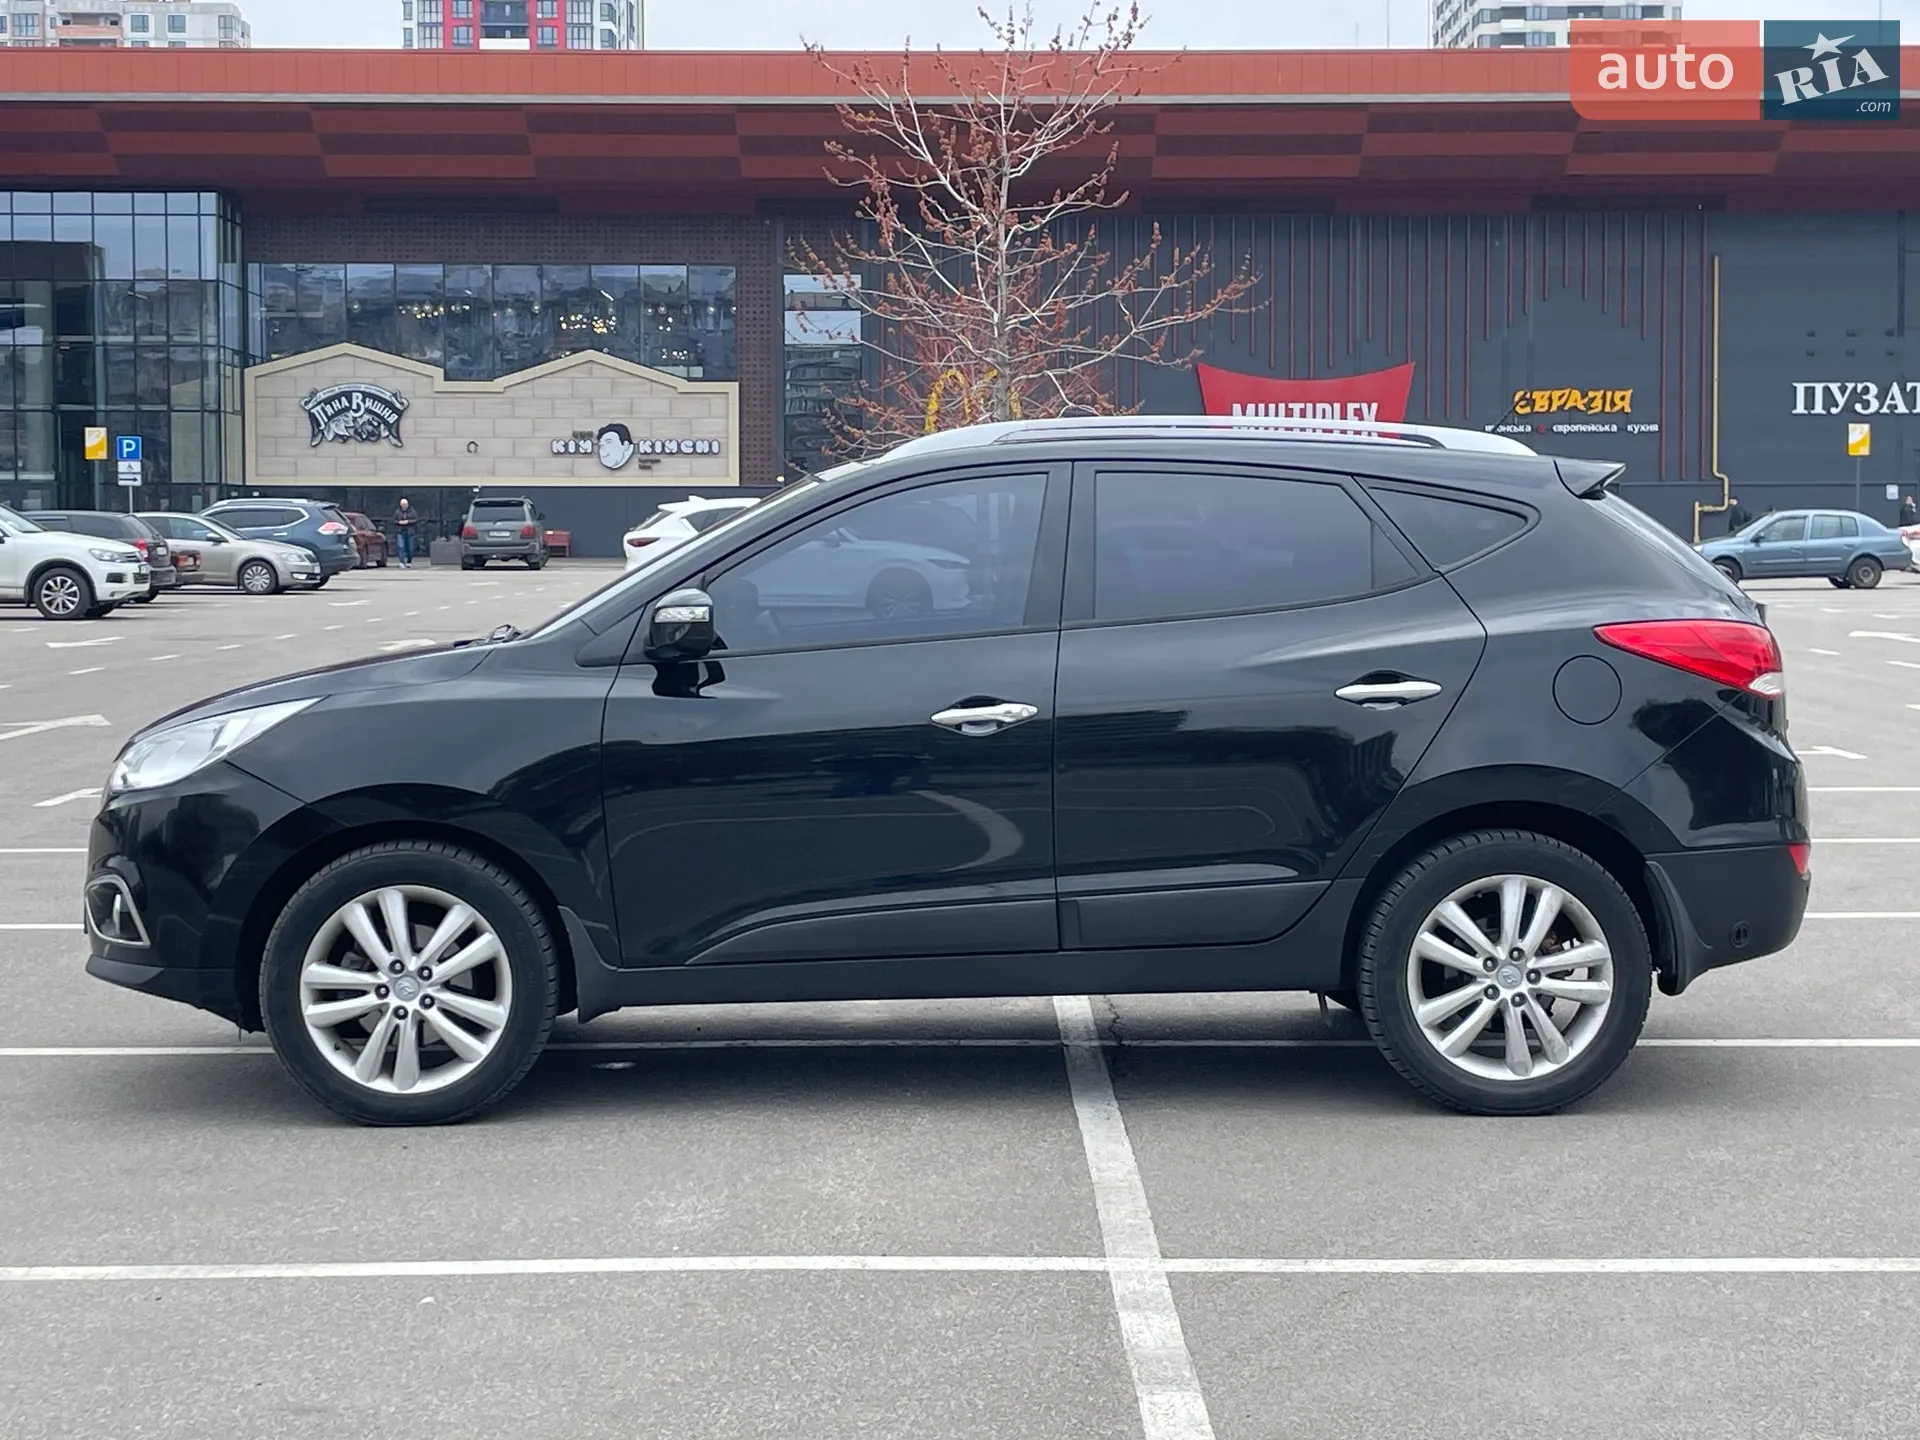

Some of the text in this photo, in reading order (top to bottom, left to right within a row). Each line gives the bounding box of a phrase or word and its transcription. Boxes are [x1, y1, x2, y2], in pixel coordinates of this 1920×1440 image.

[1513, 387, 1633, 415] ЄВРАЗІЯ
[1627, 423, 1659, 435] кухня
[122, 439, 137, 458] P
[551, 438, 721, 455] KIM KIMCHI
